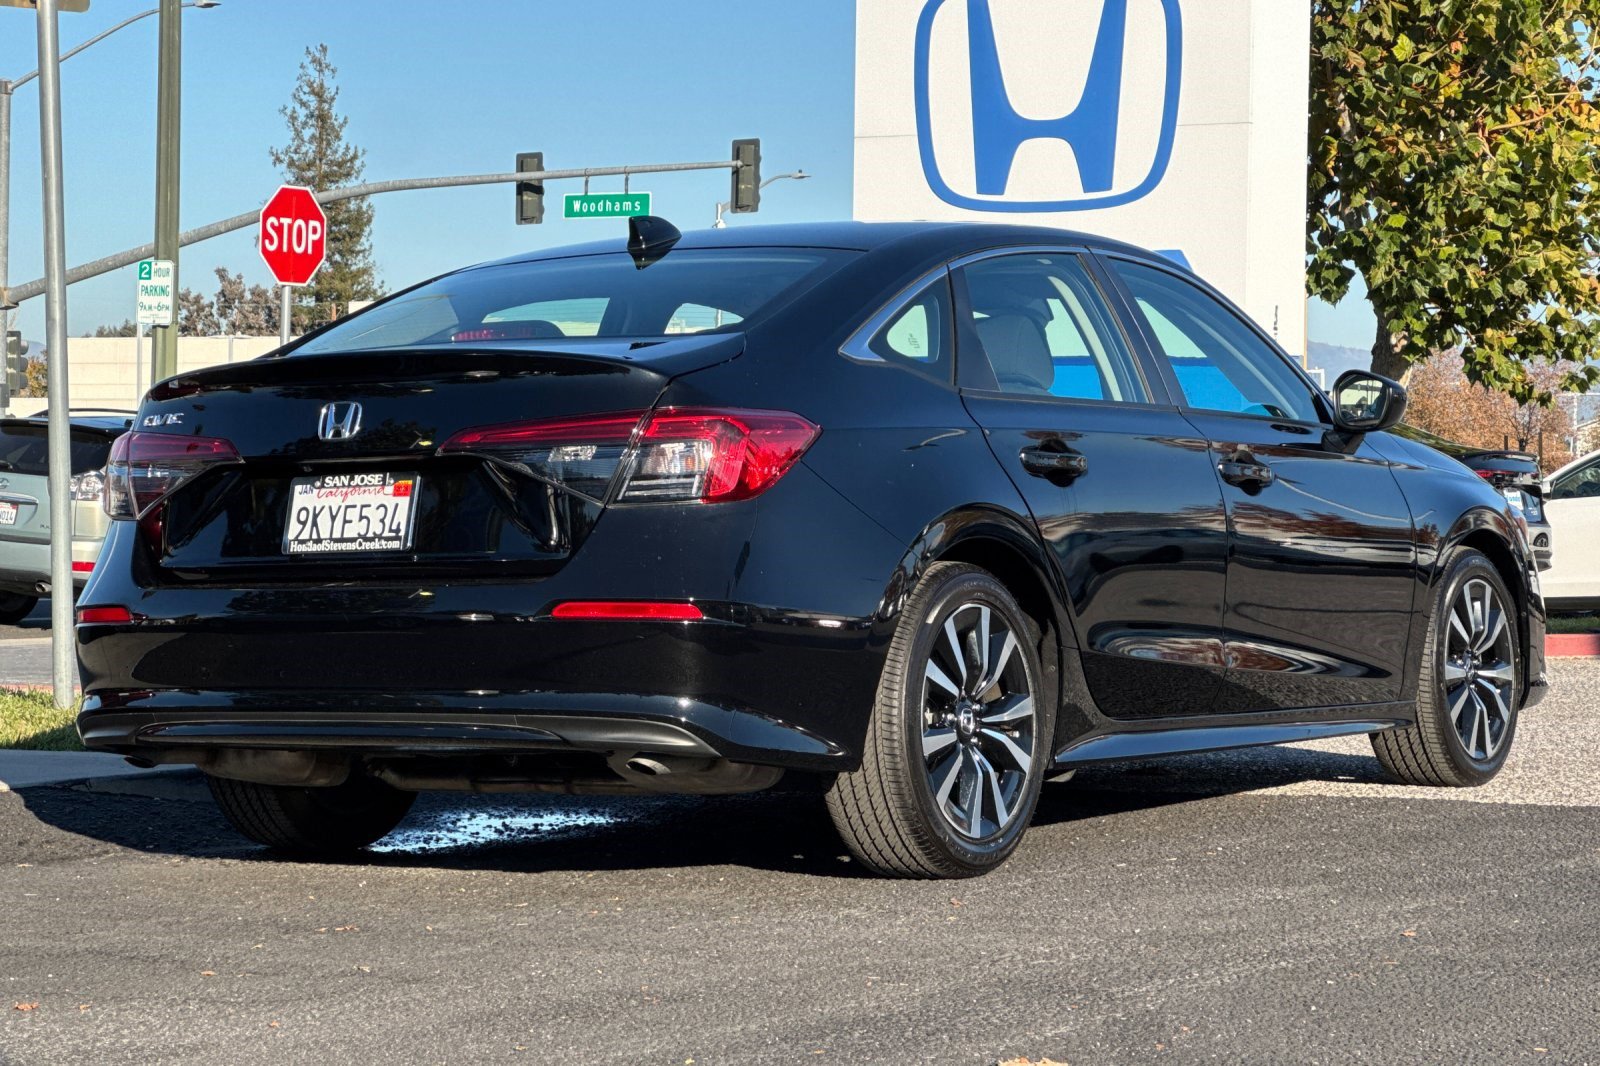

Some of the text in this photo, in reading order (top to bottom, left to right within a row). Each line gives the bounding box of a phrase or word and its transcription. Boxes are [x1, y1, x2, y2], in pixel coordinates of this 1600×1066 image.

[572, 199, 641, 213] Woodhams
[264, 216, 321, 254] STOP
[141, 263, 170, 278] 2 HOUR
[141, 285, 170, 297] PARKING
[324, 474, 383, 487] SAN JOSE
[299, 486, 314, 495] JAN
[295, 503, 402, 540] 9KYF534
[290, 539, 400, 552] HondaofStevensCreek.com
